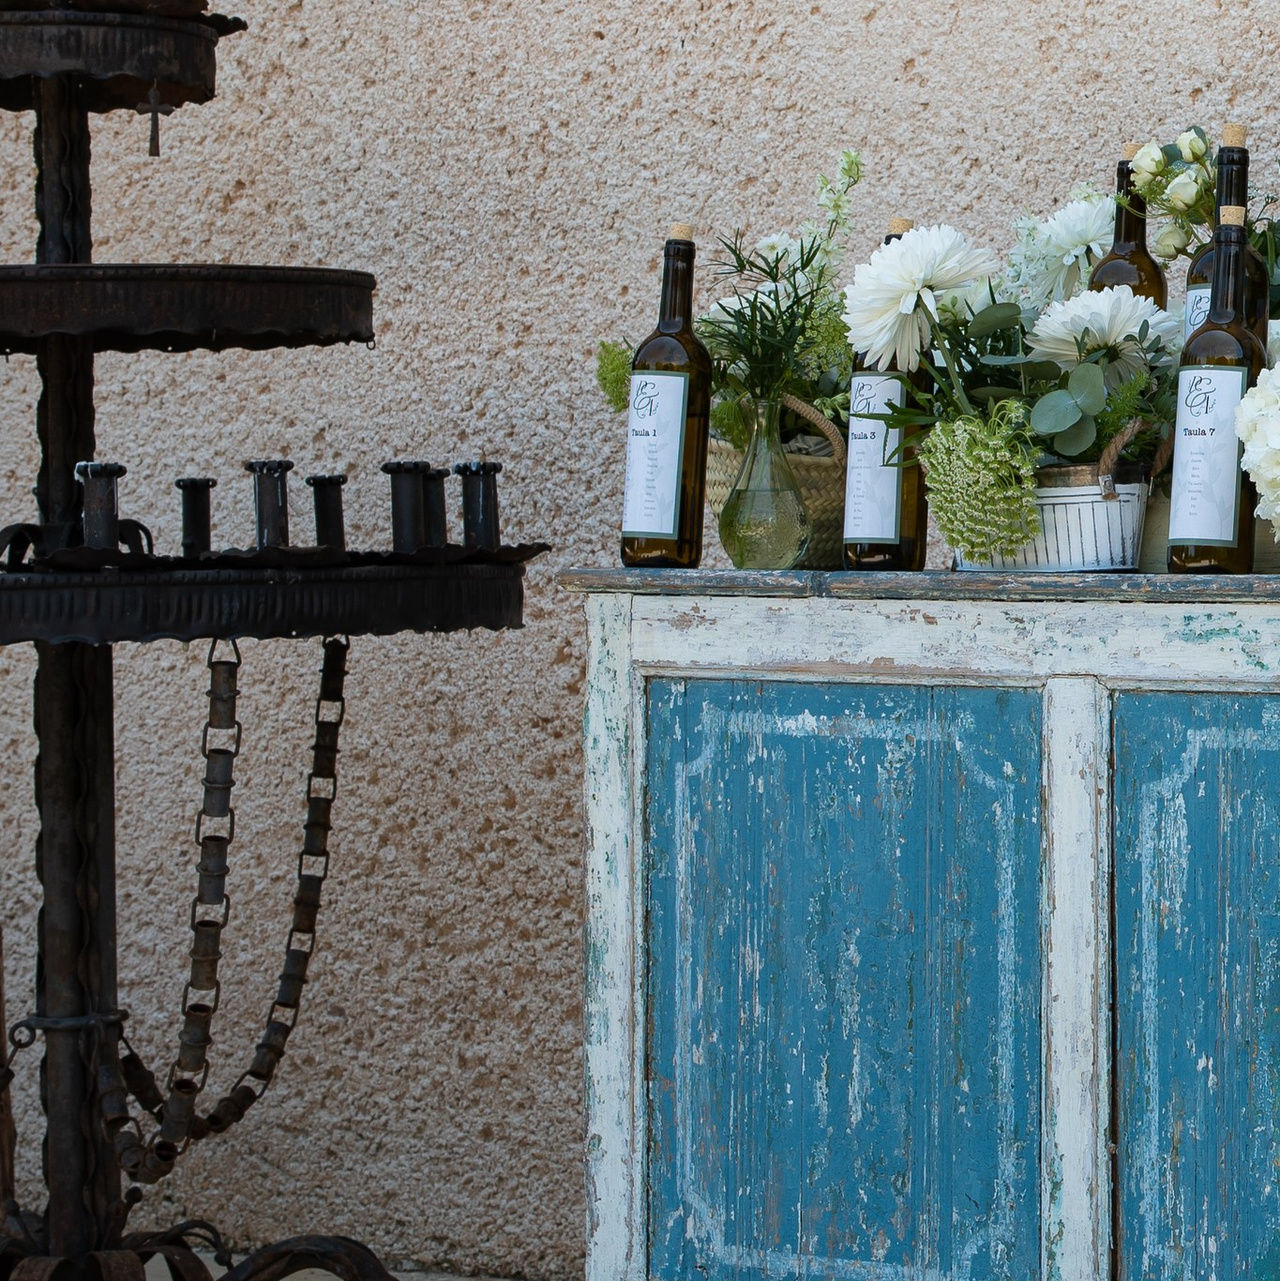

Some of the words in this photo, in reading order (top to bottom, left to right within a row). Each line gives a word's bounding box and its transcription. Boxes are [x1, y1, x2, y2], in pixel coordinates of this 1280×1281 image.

[632, 429, 650, 437] Taula
[652, 429, 657, 437] 1
[851, 431, 868, 440] Taula
[870, 431, 876, 440] 3
[1183, 428, 1207, 436] Taula
[1209, 428, 1216, 436] 7
